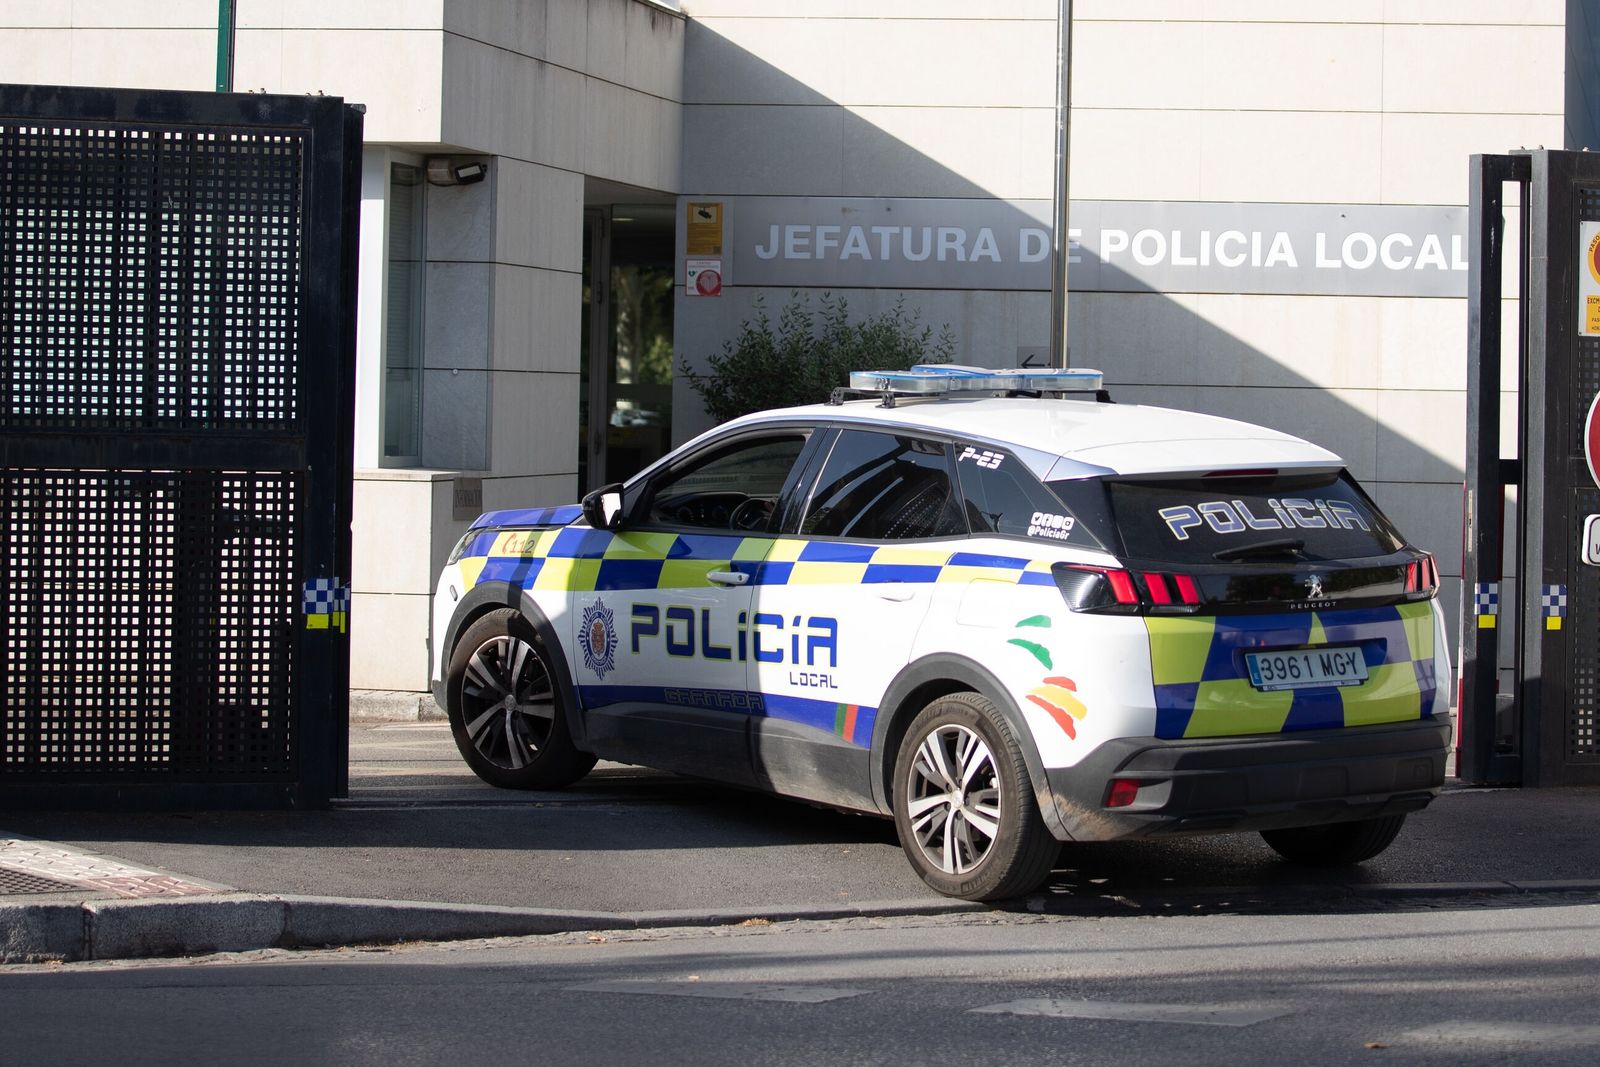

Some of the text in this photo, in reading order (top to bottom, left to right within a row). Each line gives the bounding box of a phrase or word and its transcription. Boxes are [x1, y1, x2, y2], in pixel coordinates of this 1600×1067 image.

[755, 224, 1002, 262] JEFATURA
[1100, 228, 1298, 267] POLICIA
[1315, 232, 1469, 271] LOCAL
[958, 447, 1005, 470] P-23
[509, 539, 535, 553] 112
[1290, 601, 1337, 609] PEUGEOT
[1260, 651, 1358, 682] 3961 MGY
[789, 671, 838, 689] LOCAL
